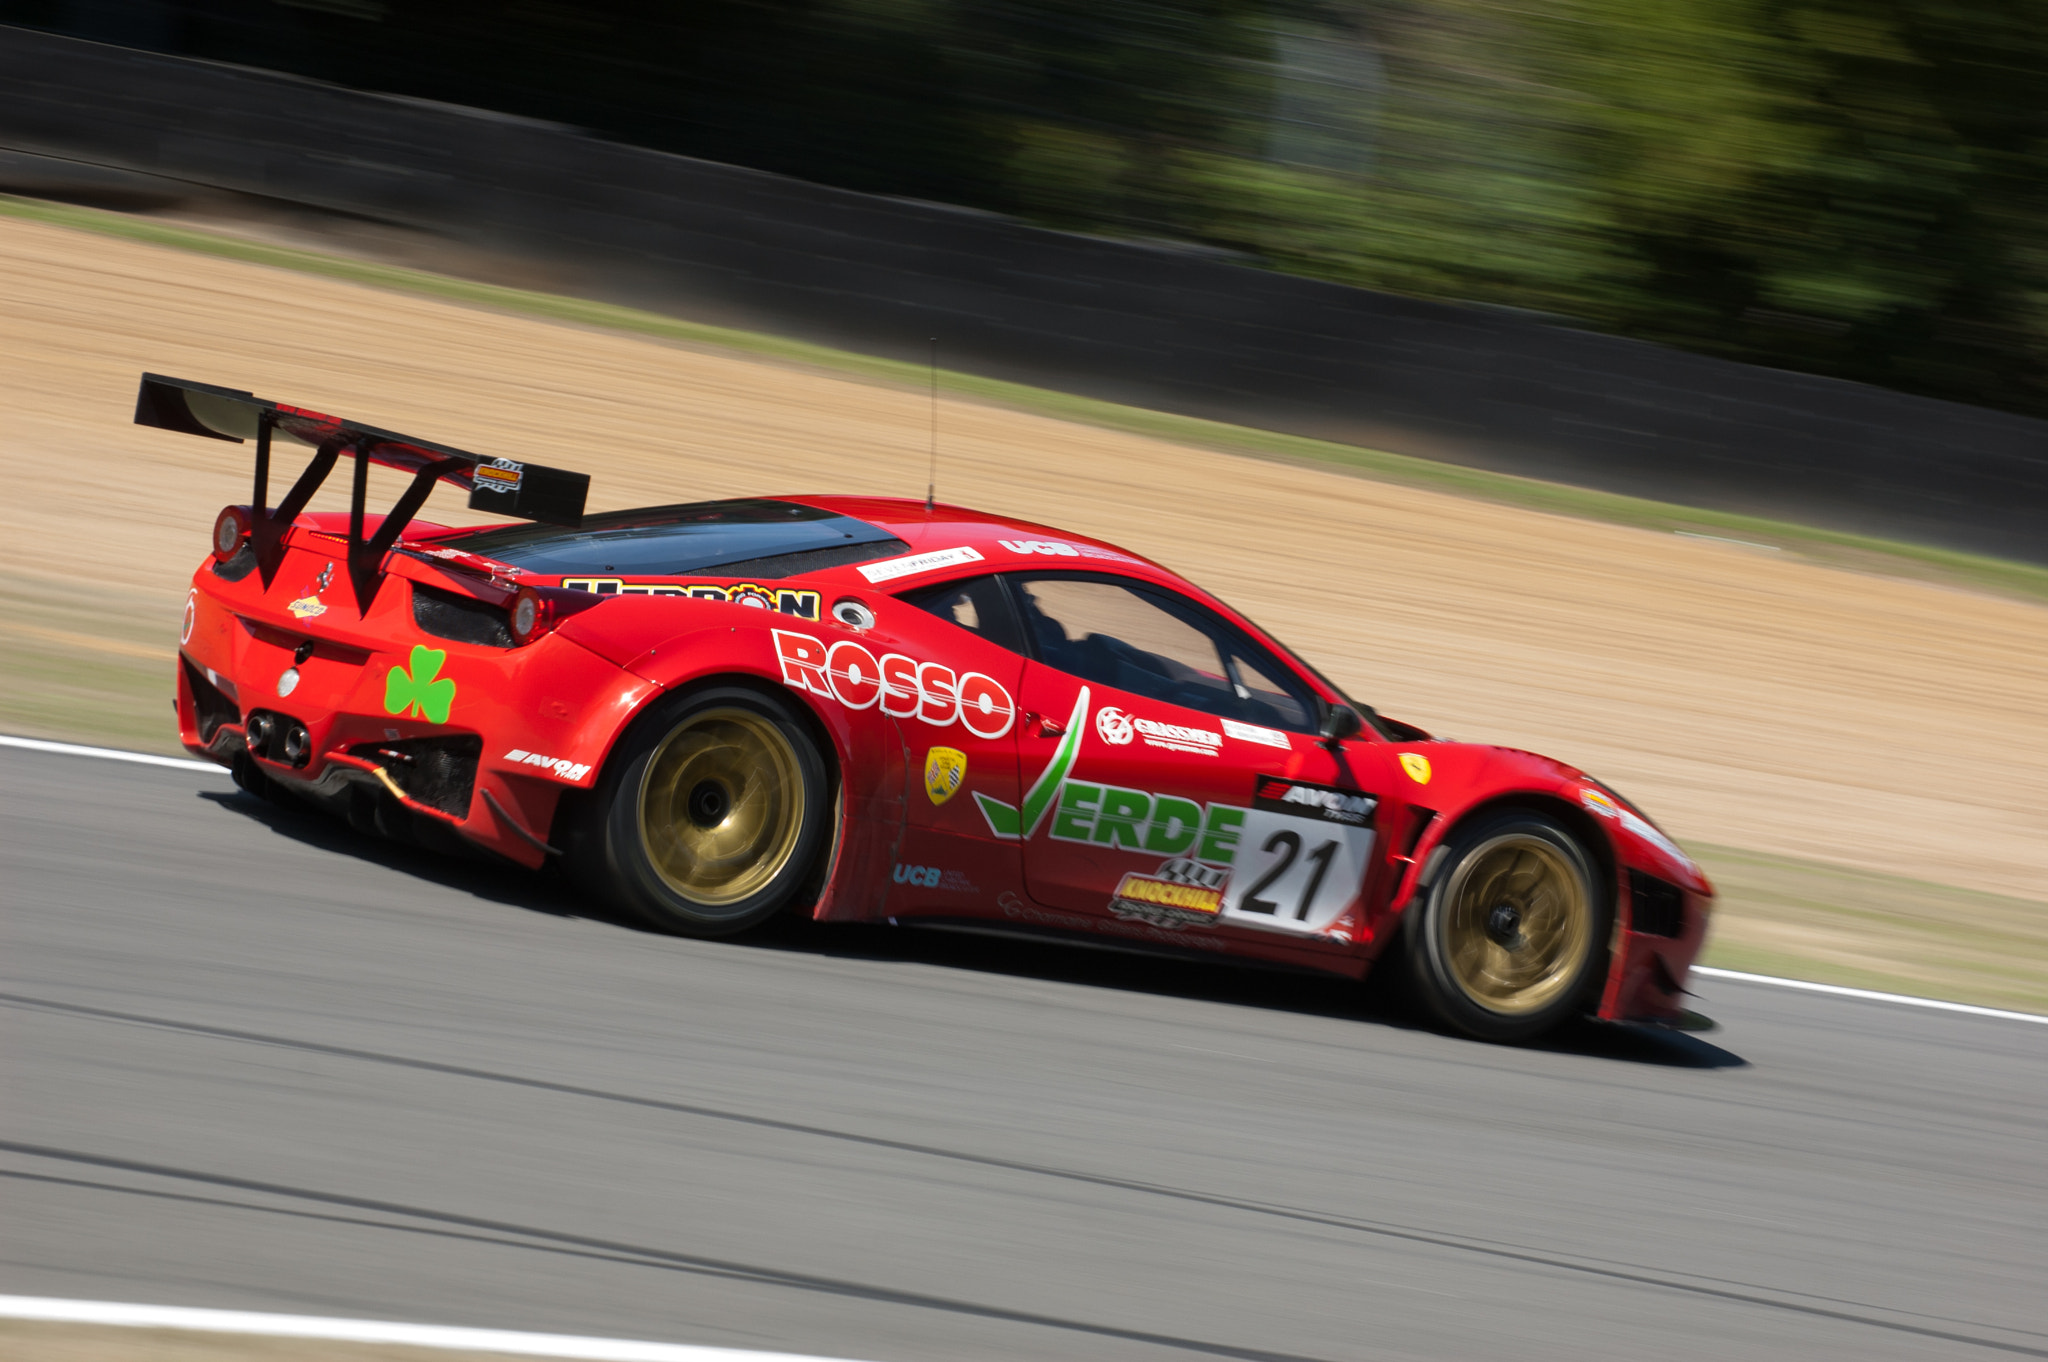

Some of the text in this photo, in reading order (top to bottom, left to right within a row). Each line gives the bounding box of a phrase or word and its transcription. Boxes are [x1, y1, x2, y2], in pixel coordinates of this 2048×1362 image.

[771, 628, 1016, 740] ROSSO
[521, 753, 592, 776] AVON
[971, 685, 1247, 866] VERDE
[893, 863, 942, 888] UCB
[1119, 876, 1222, 913] KNOCKHILL
[1237, 829, 1343, 922] 21
